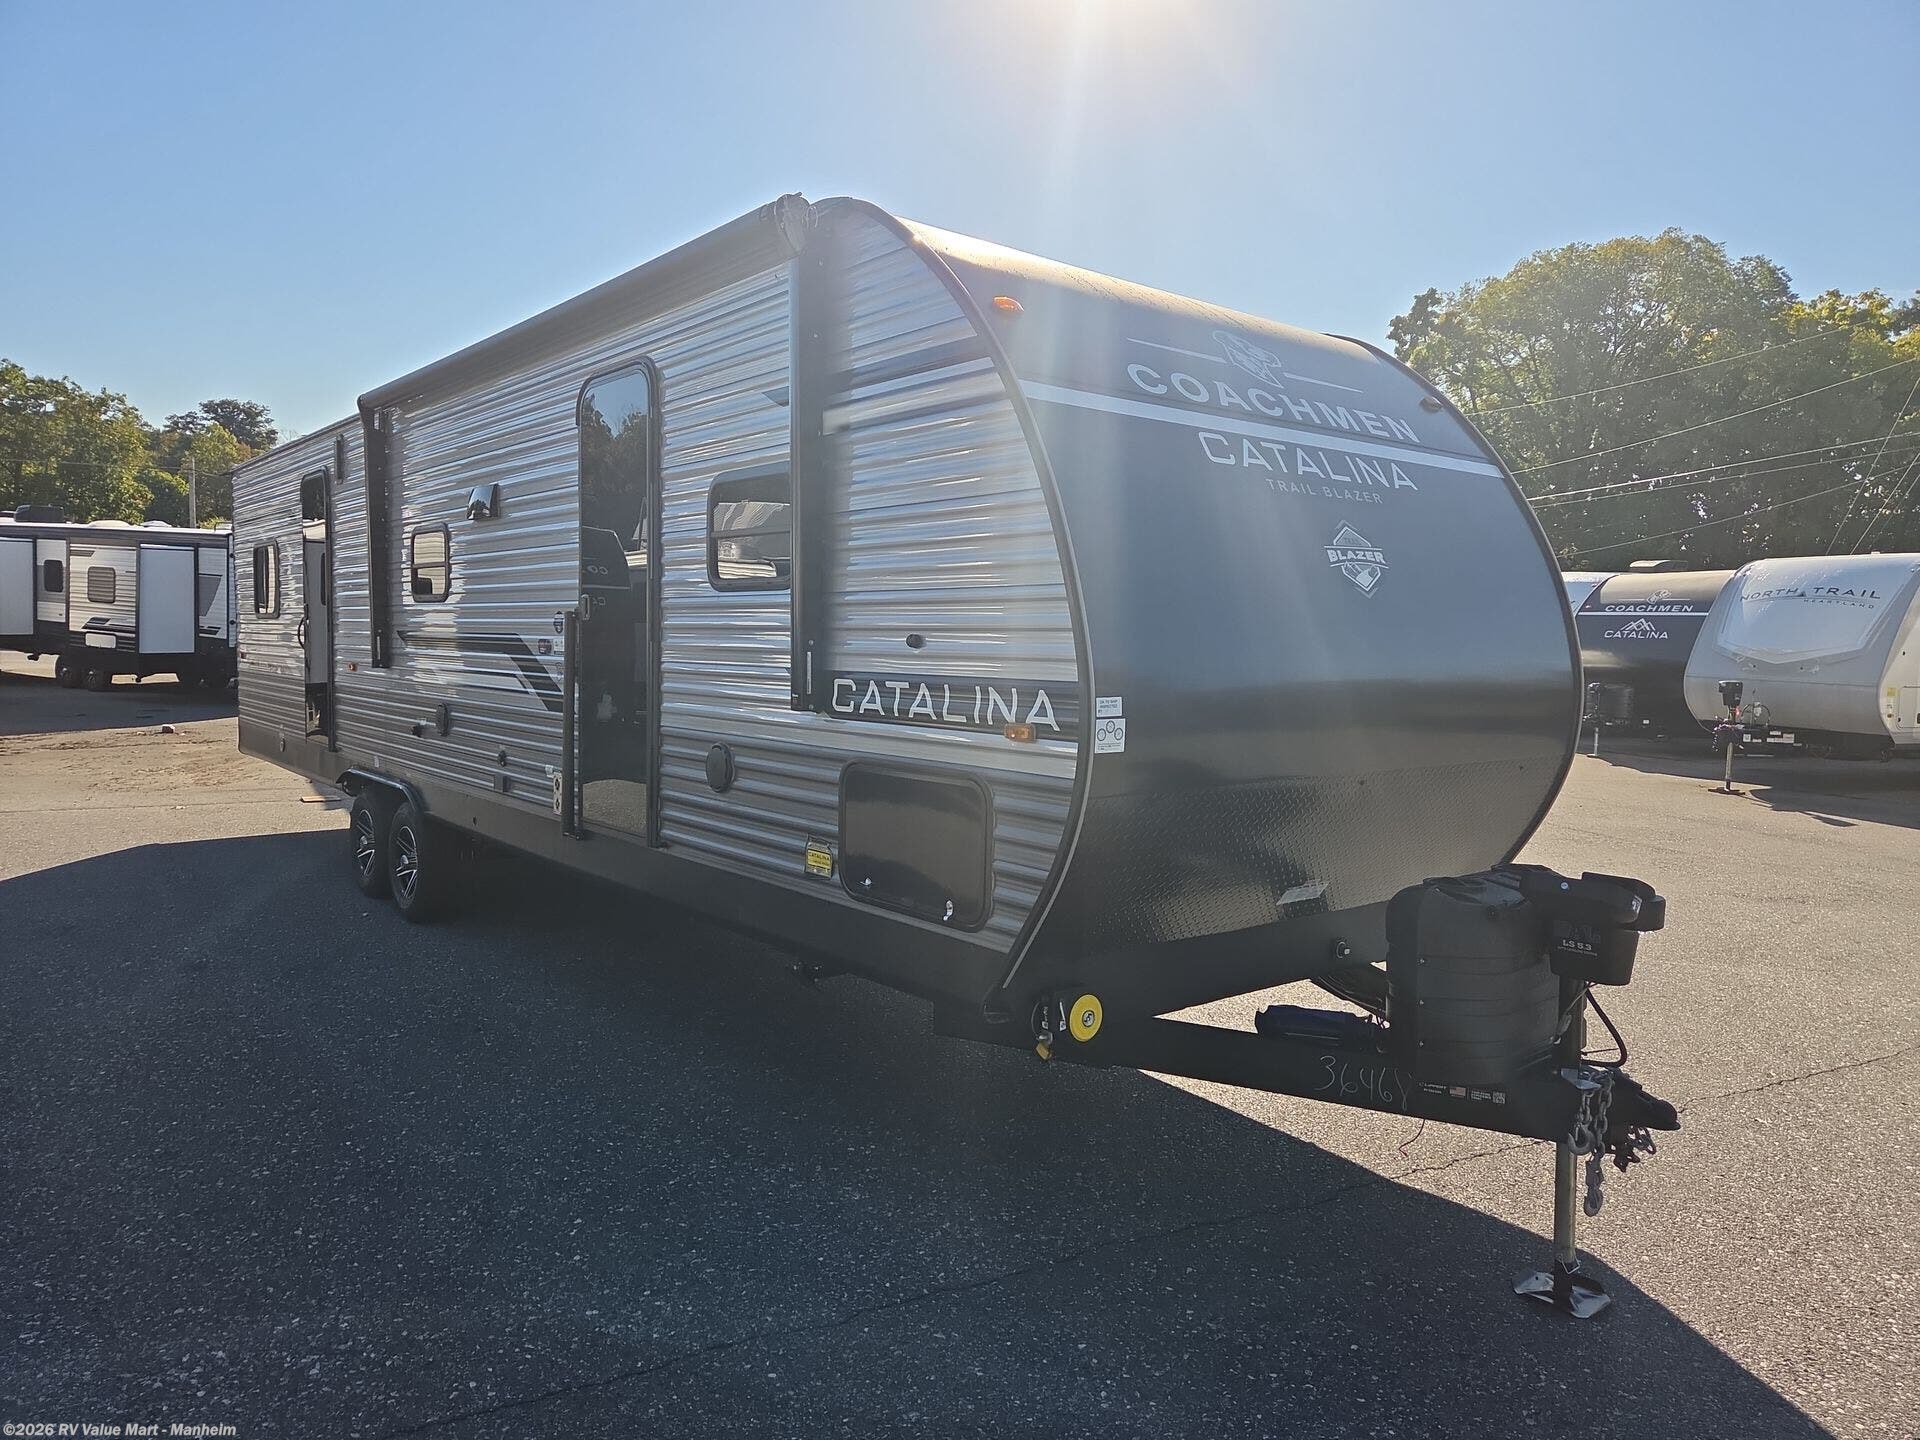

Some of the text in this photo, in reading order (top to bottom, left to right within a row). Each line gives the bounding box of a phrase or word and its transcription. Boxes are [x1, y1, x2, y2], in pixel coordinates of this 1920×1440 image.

[1126, 363, 1421, 444] COACHMEN
[1198, 430, 1418, 491] CATALINA
[1265, 478, 1383, 504] TRAIL BLAZER
[1326, 549, 1387, 564] BLAZER
[1740, 587, 1881, 601] NORTH TRAIL
[1604, 604, 1694, 613] COACHMEN
[1604, 630, 1669, 640] CATALINA
[831, 678, 1061, 732] CATALINA
